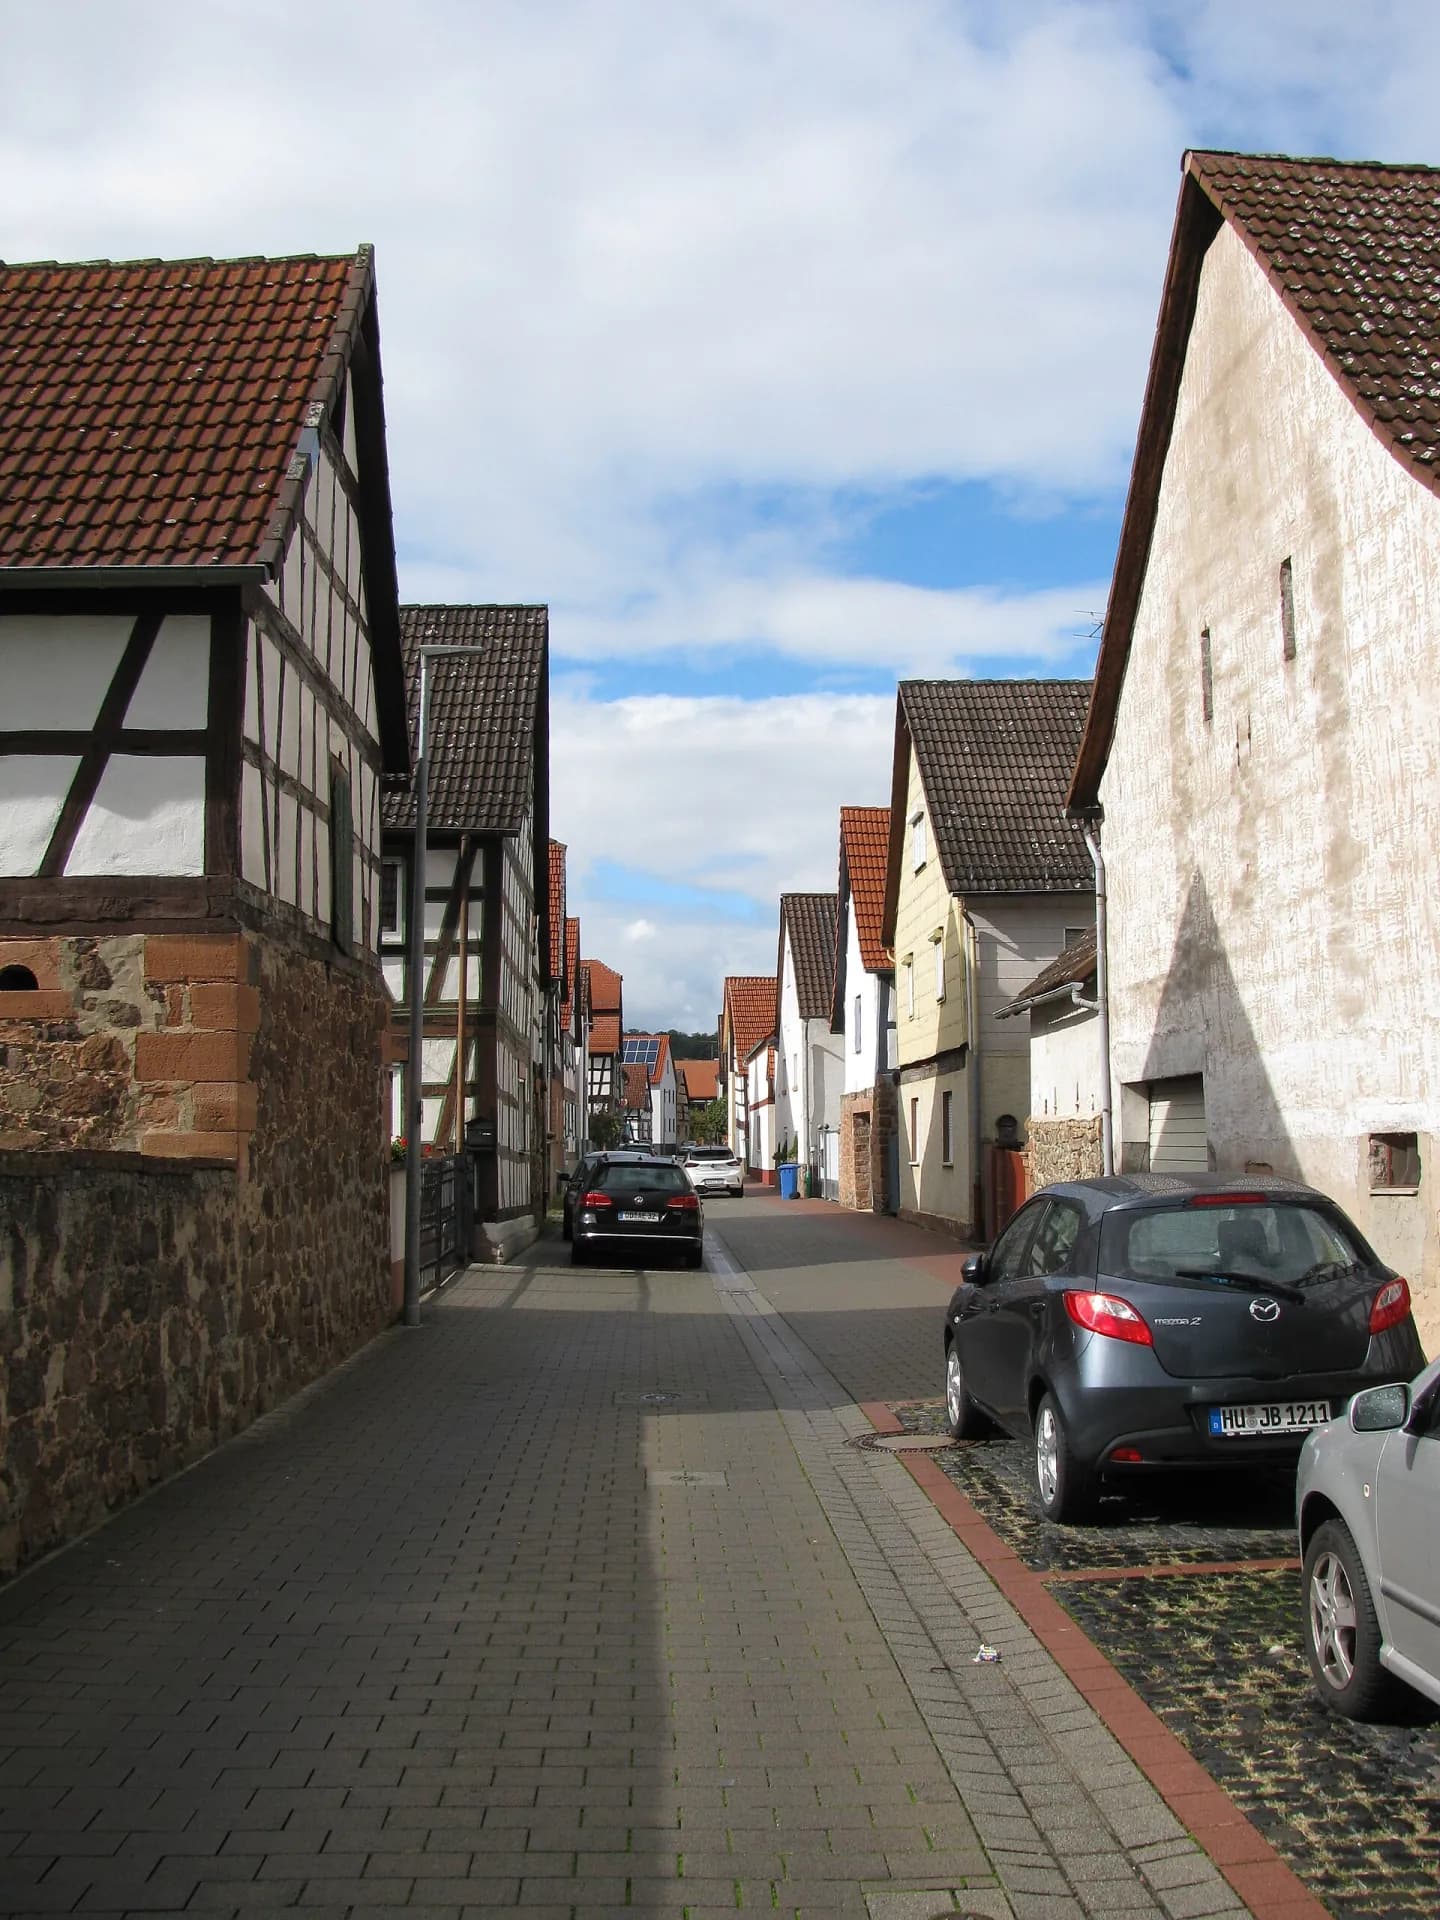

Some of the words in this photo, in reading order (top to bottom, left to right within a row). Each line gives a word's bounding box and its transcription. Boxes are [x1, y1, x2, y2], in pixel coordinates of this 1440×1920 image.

[1154, 1318, 1189, 1326] mazda
[1190, 1316, 1202, 1326] 2
[1222, 1408, 1246, 1430] HU
[1260, 1406, 1282, 1427] JB
[1286, 1403, 1329, 1426] 1211
